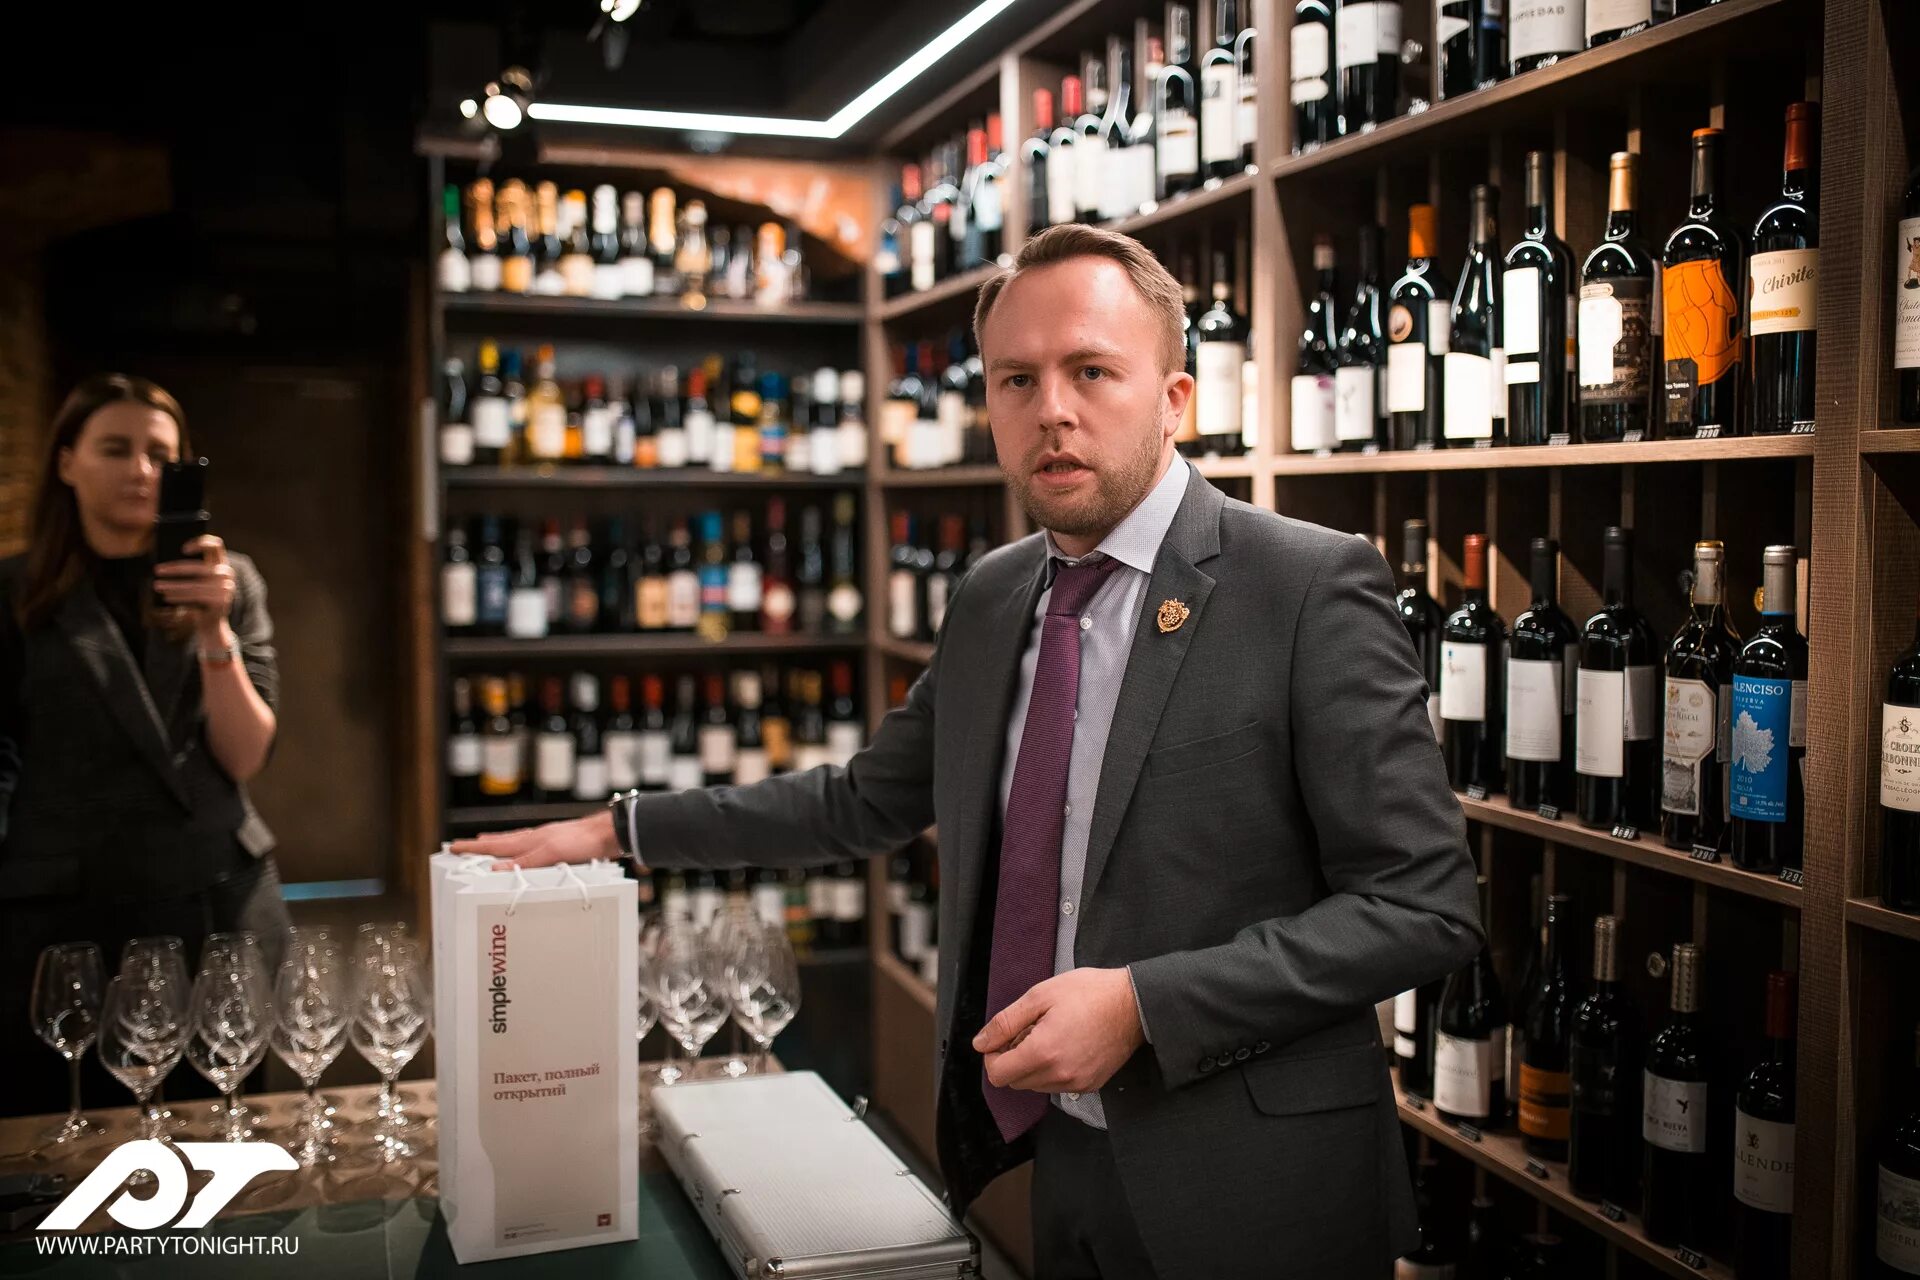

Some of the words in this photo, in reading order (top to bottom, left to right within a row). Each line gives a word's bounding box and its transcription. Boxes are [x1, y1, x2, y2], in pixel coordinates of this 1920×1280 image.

[1763, 265, 1815, 294] Chivite
[488, 924, 512, 1034] simplewine
[493, 1072, 542, 1084] Пакет,
[544, 1062, 601, 1082] полный
[493, 1083, 566, 1101] открытий
